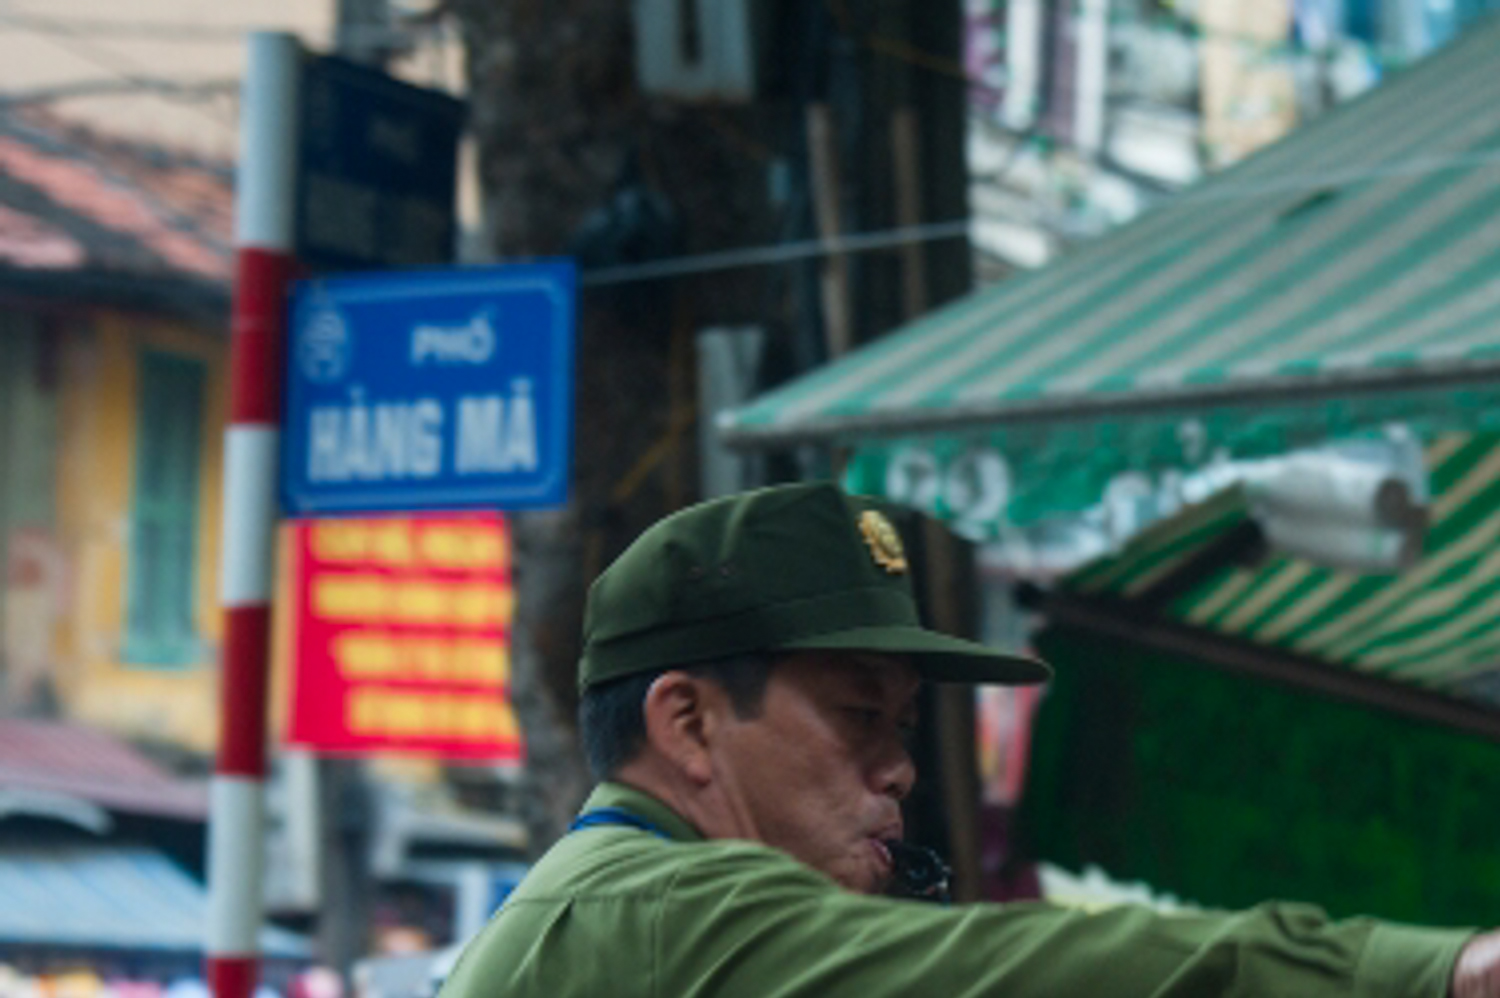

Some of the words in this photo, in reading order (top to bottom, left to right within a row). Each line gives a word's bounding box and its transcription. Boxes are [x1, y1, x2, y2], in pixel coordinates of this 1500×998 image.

[411, 308, 495, 367] PHỐ
[308, 386, 442, 480] HÀNG
[455, 377, 537, 472] MÃ
